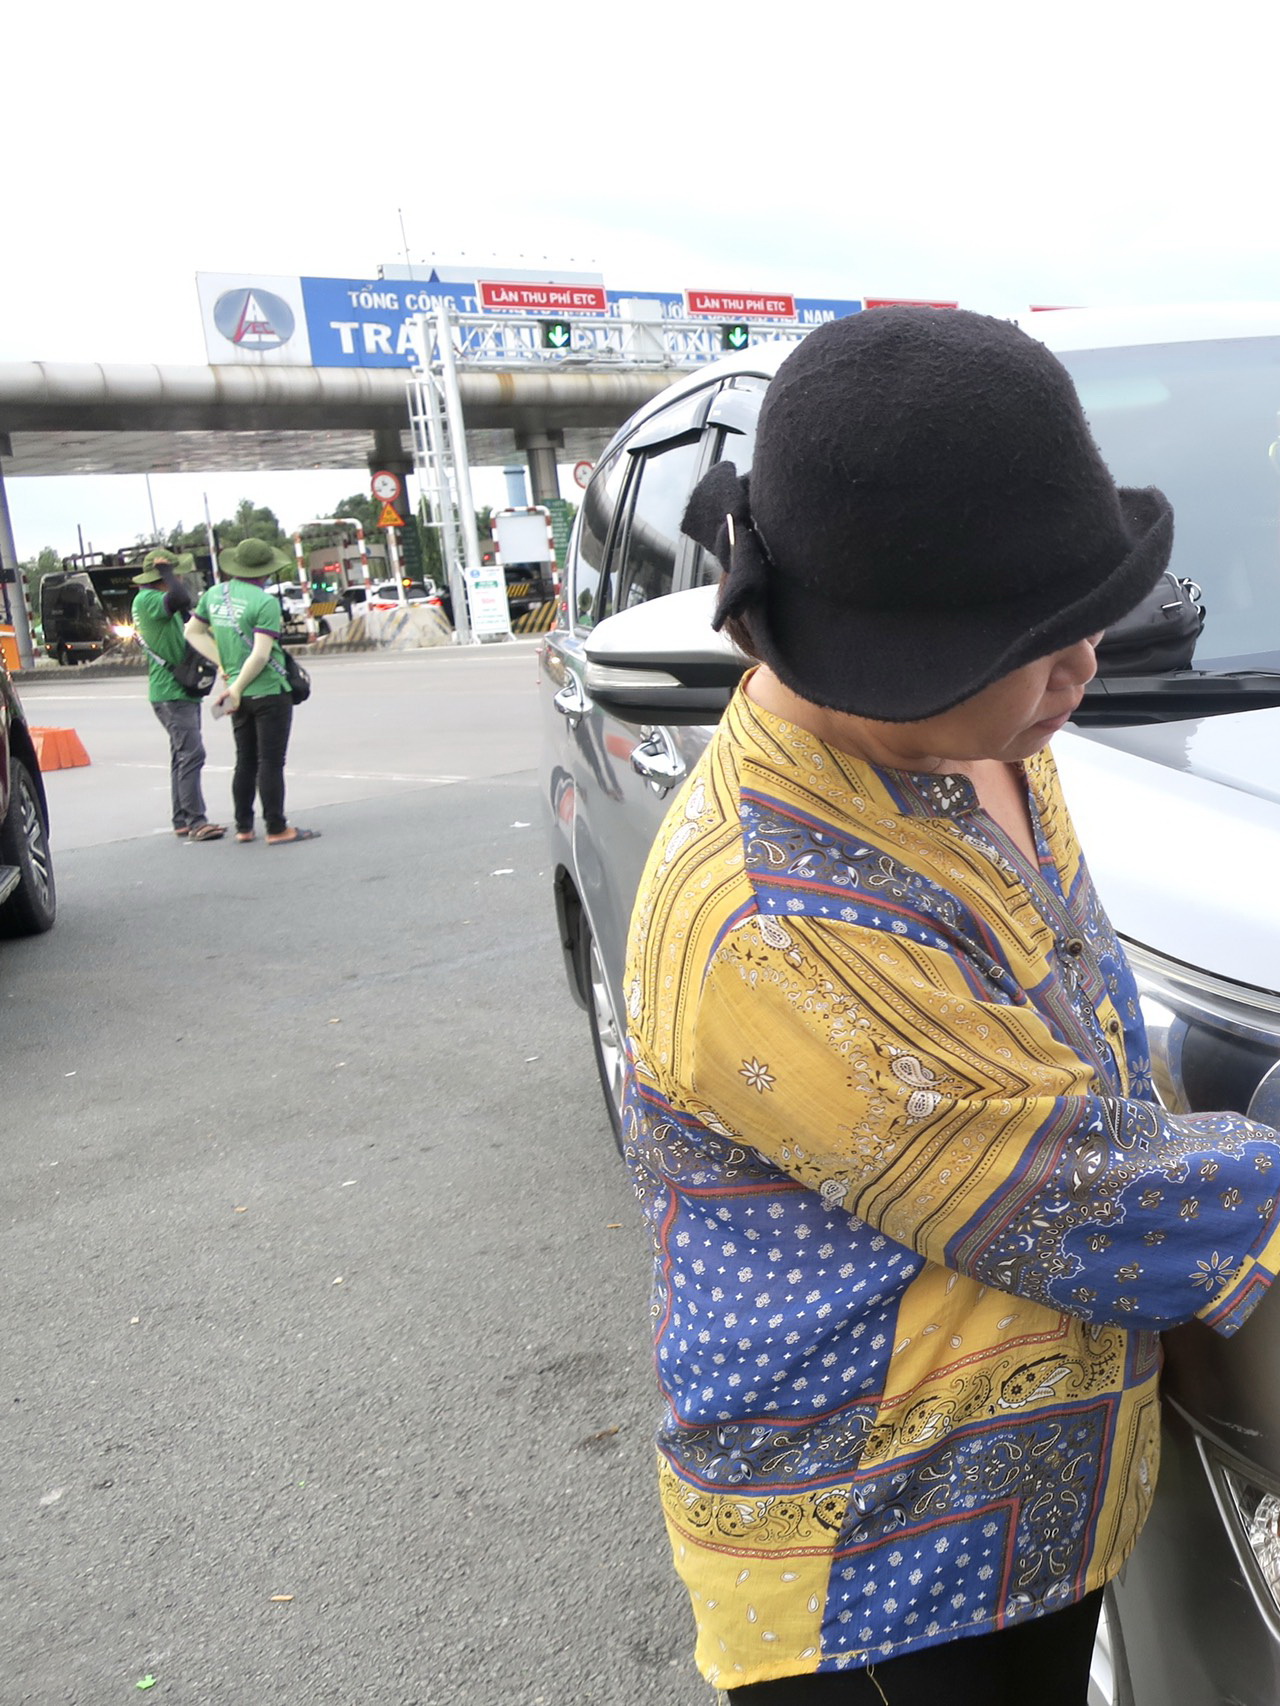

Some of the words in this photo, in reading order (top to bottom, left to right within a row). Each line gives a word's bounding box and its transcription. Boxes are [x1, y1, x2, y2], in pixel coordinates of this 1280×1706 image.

[347, 284, 399, 310] TỔNG
[405, 290, 456, 311] CÔNG
[491, 288, 519, 303] LÀN
[521, 291, 549, 304] THU
[551, 291, 571, 305] PHÍ
[573, 294, 596, 305] ETC
[696, 295, 719, 309] LÀN
[721, 298, 745, 310] THU
[746, 298, 764, 310] PHÍ
[766, 300, 786, 312] ETC
[803, 309, 835, 323] NAM
[209, 603, 245, 618] VEC
